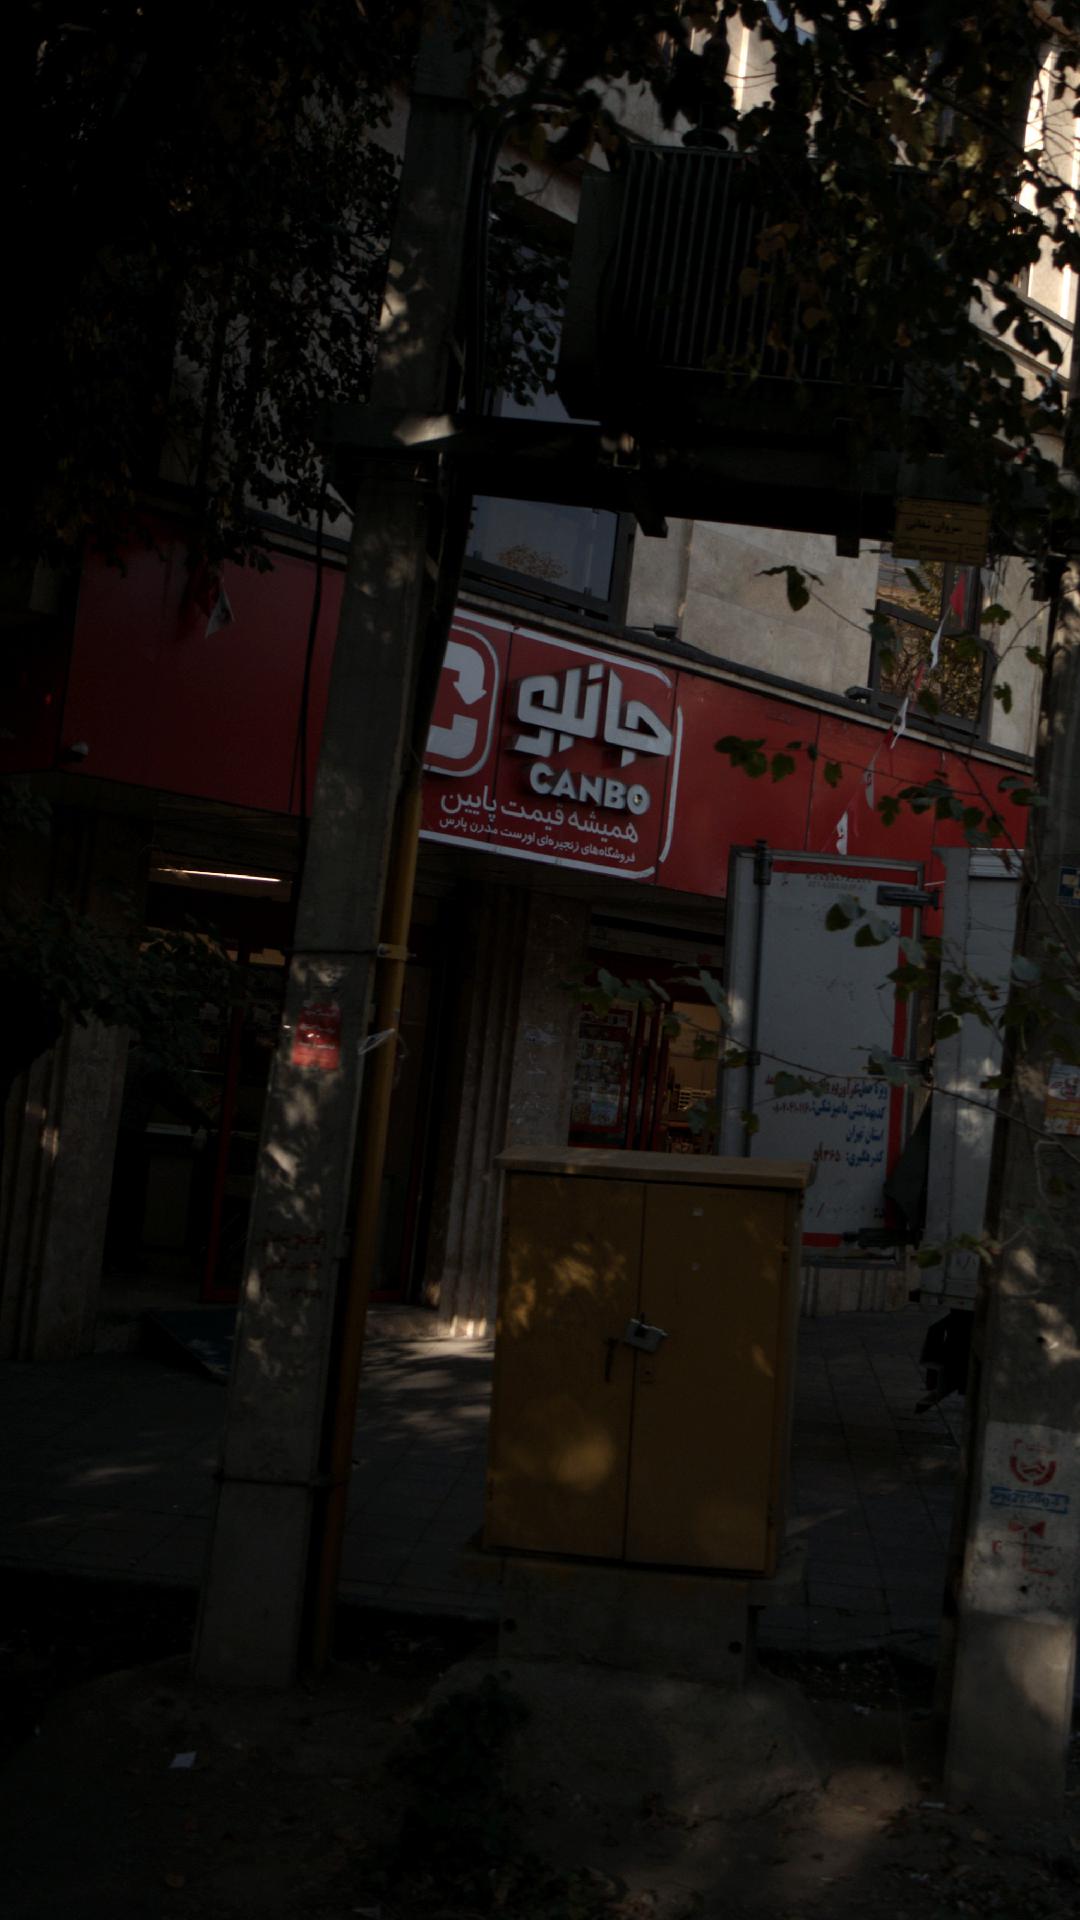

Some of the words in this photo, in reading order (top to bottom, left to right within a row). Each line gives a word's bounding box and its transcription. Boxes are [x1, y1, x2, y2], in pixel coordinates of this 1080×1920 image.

[440, 785, 497, 822] پایین
[529, 762, 651, 815] CANBO
[500, 800, 564, 832] قیمت
[568, 811, 639, 844] همیشه
